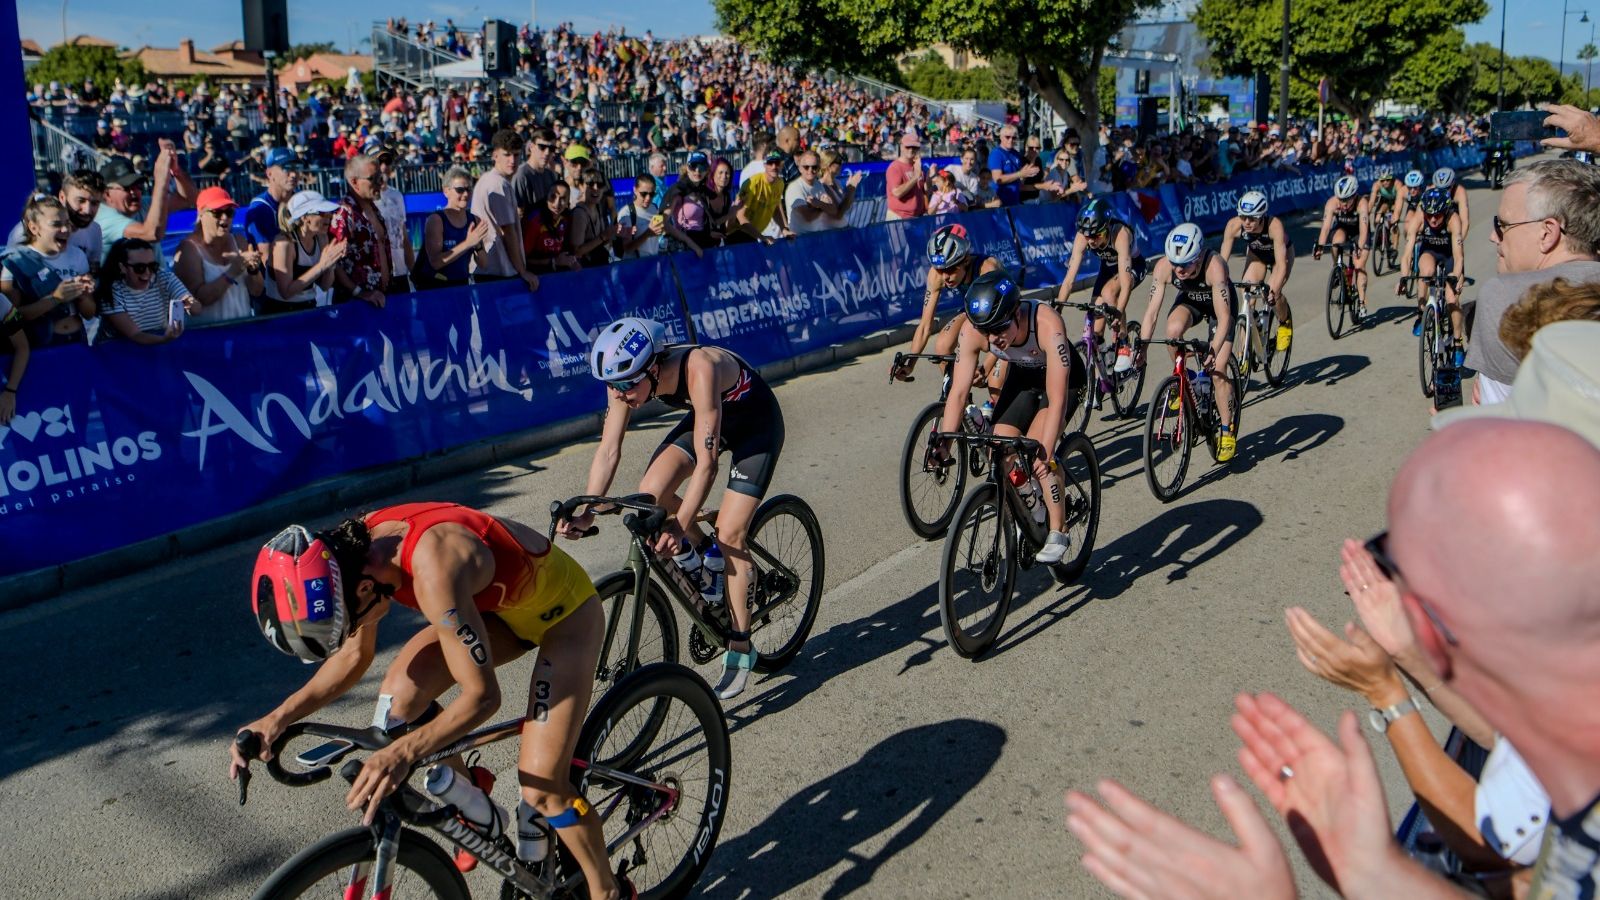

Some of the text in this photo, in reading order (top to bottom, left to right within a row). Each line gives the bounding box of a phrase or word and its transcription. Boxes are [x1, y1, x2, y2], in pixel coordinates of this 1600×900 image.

[613, 327, 638, 357] TREK
[630, 342, 639, 351] 36
[182, 312, 530, 471] Andalucía
[1050, 484, 1061, 504] 29
[313, 599, 326, 614] 30
[456, 623, 488, 666] 30
[533, 679, 551, 722] 30
[442, 817, 517, 877] WORKS
